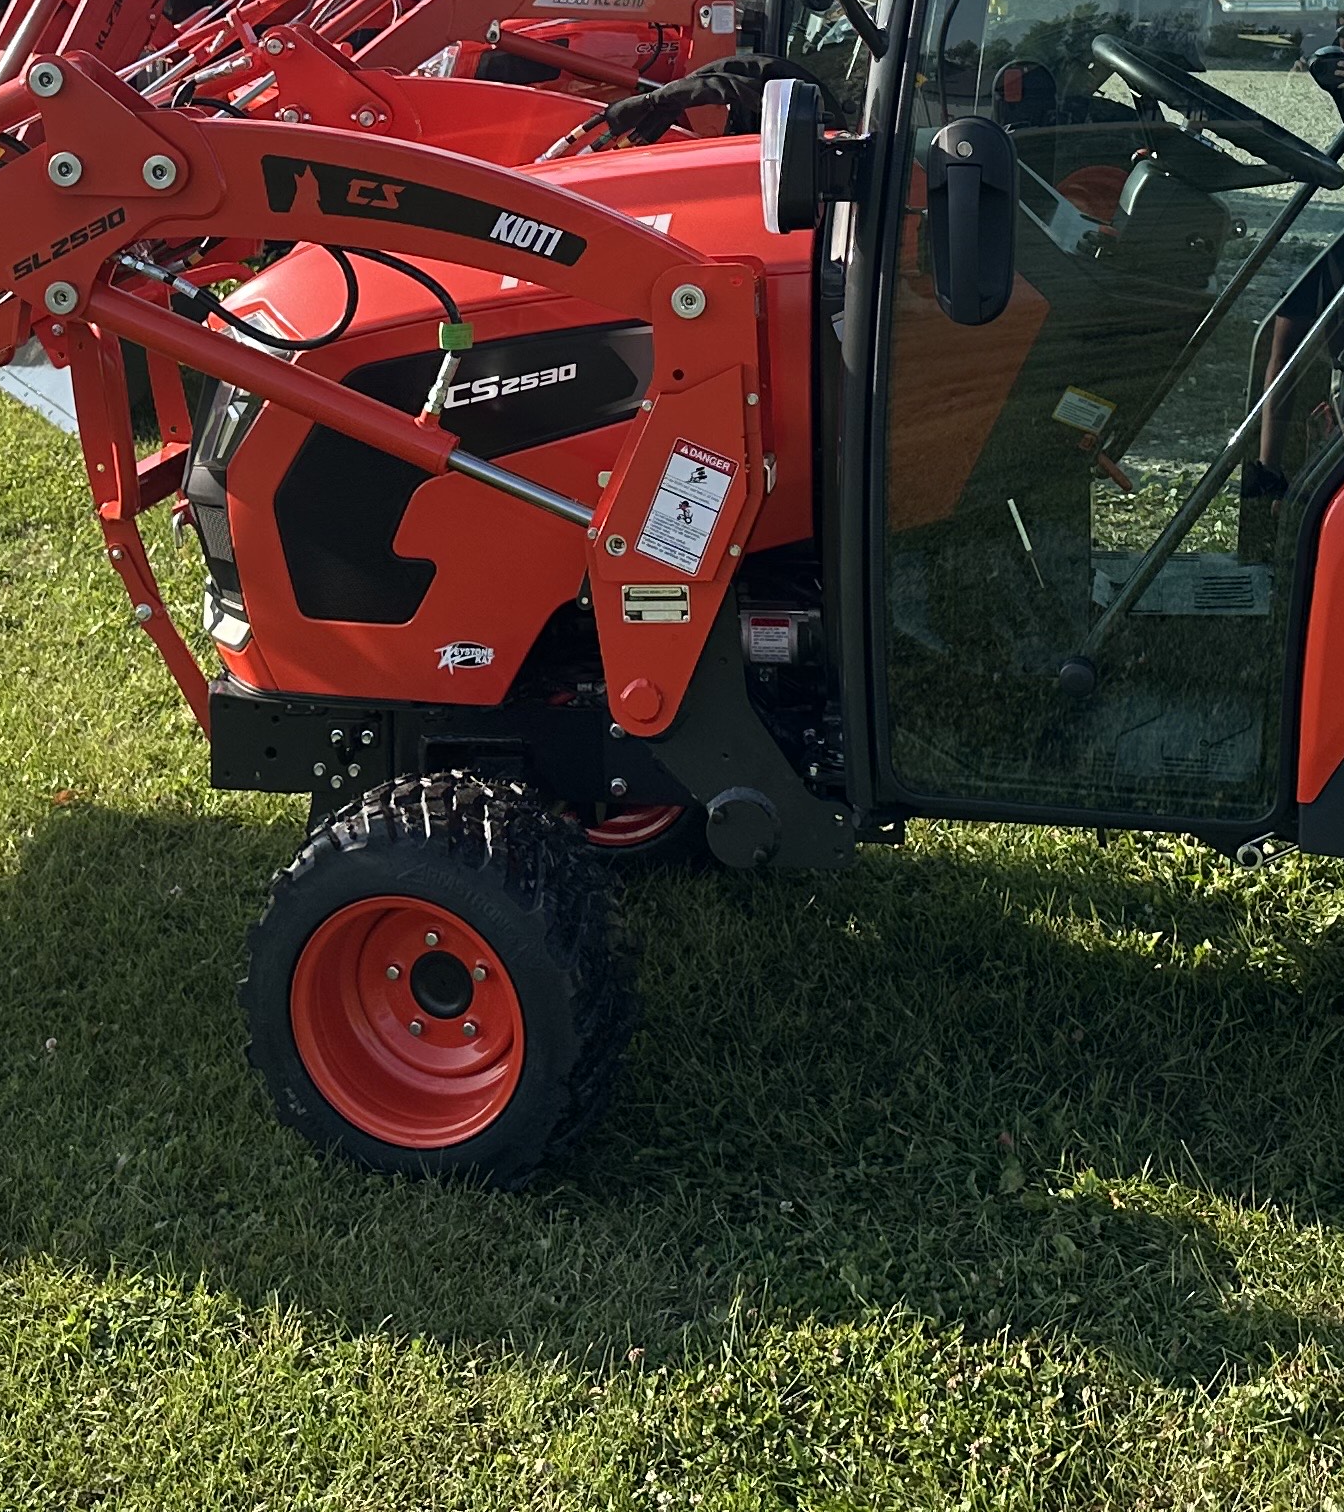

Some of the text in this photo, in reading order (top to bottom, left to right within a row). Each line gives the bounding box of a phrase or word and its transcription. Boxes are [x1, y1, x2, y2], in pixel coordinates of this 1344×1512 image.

[346, 178, 406, 209] CS
[12, 206, 126, 281] SL2530
[490, 211, 563, 256] KIOTI
[687, 448, 731, 471] DANGER
[434, 644, 495, 675] KEYSTONE
